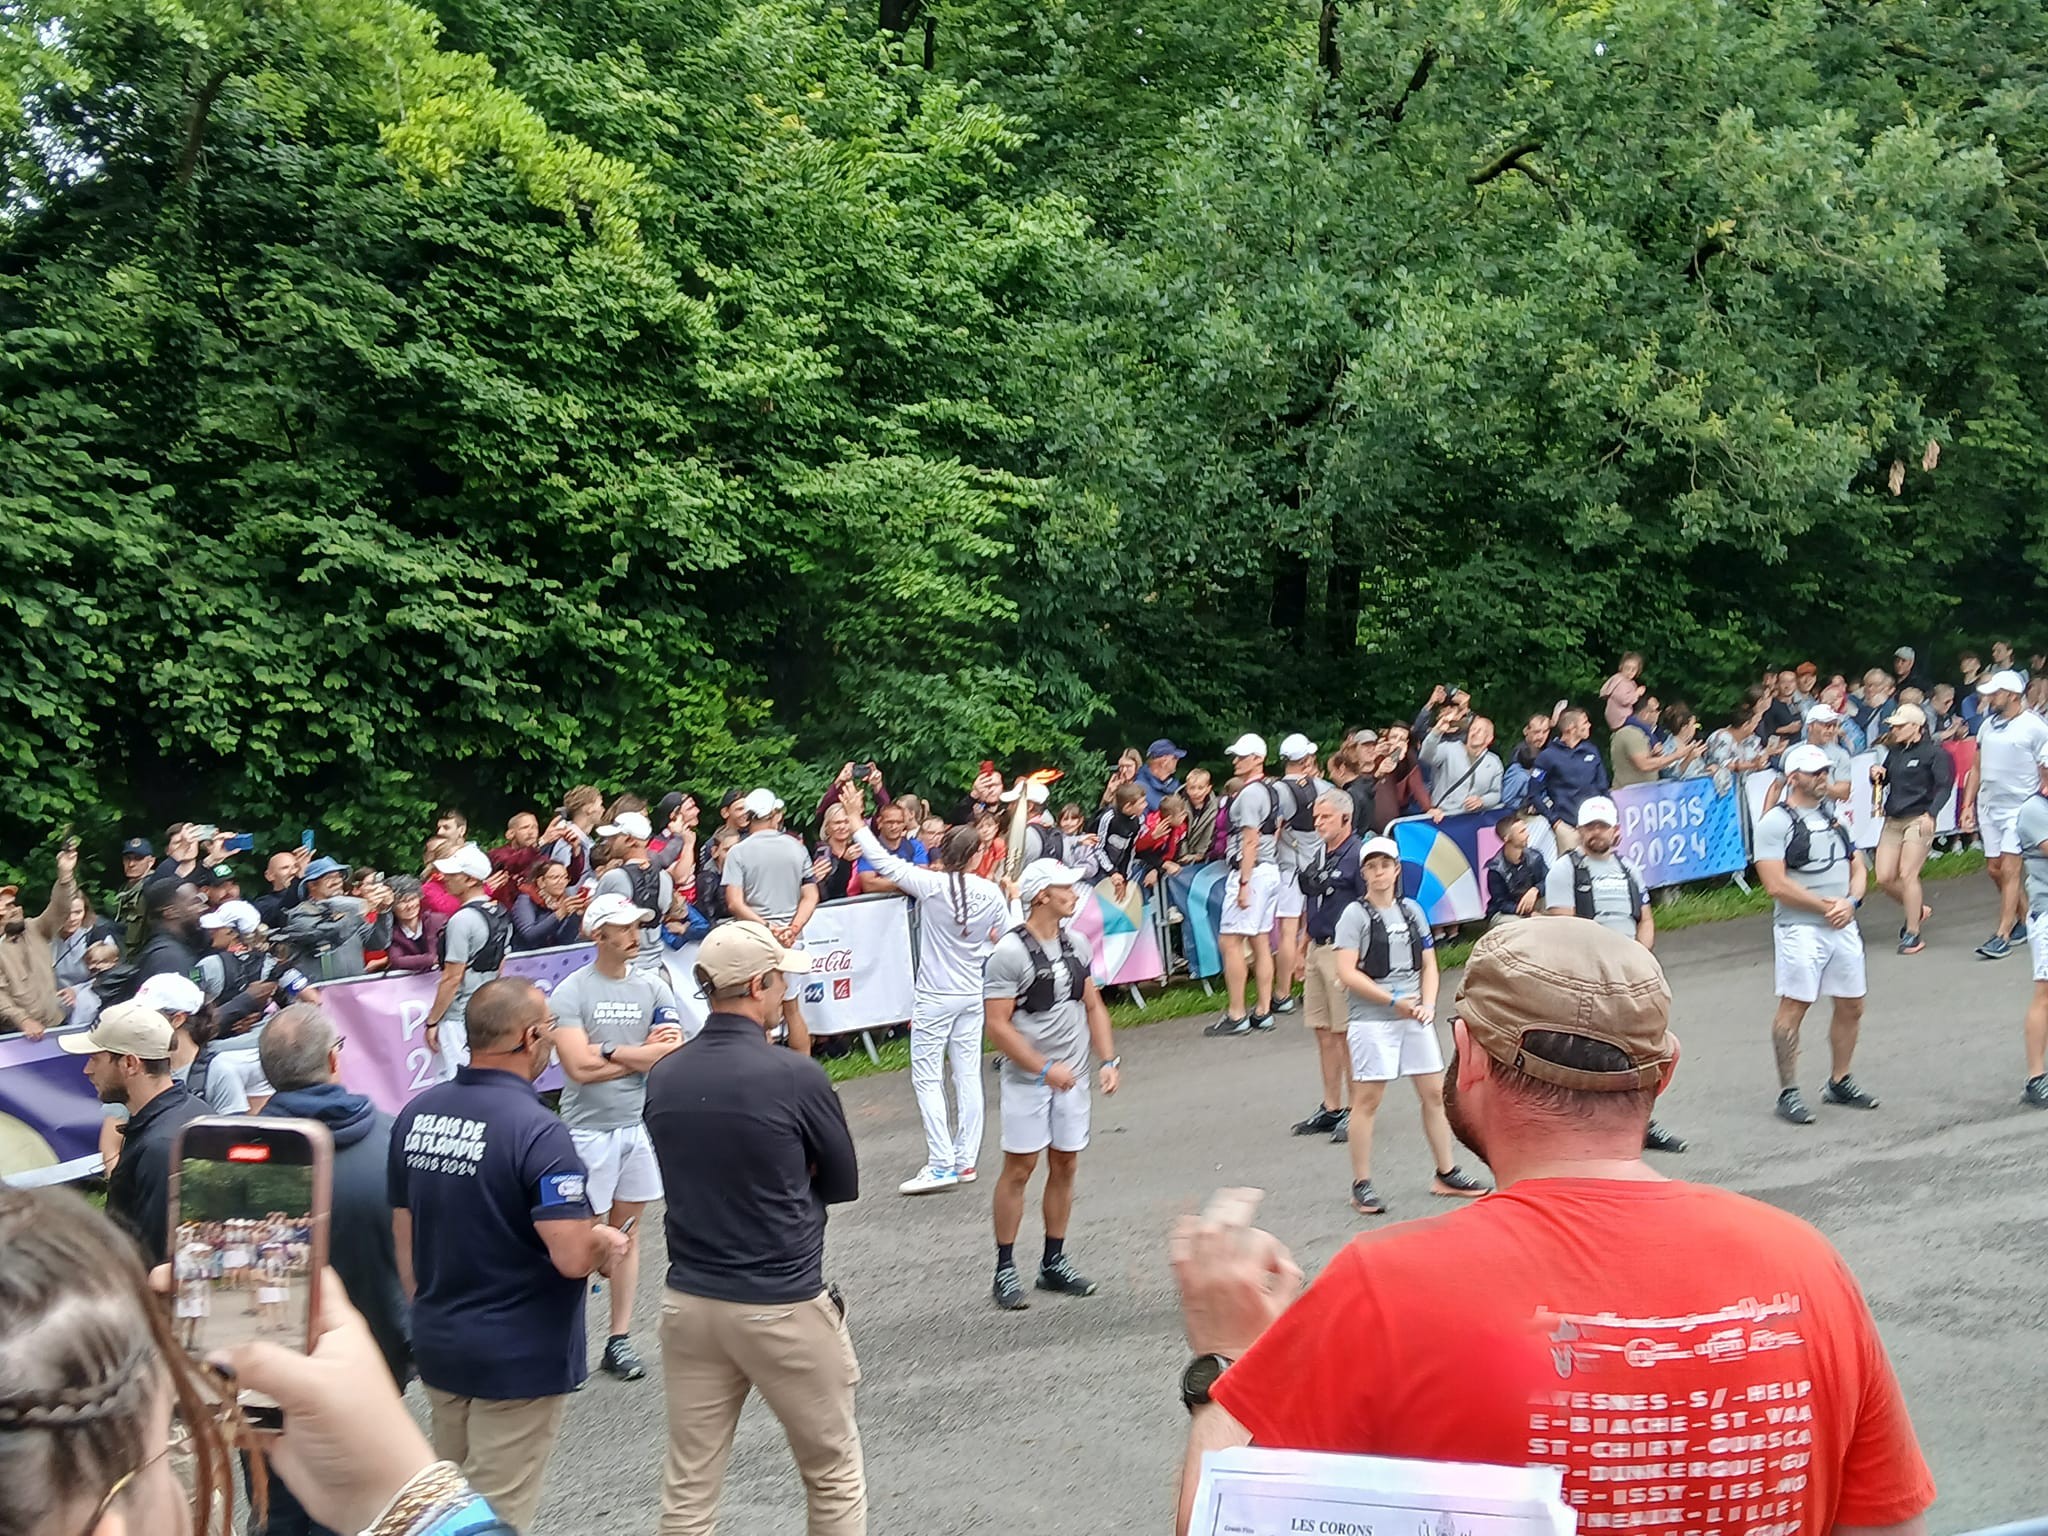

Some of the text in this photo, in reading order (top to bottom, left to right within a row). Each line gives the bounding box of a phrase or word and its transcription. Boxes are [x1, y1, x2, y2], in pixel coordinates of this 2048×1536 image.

[1628, 831, 1706, 871] 2024
[411, 1113, 487, 1140] RELAIS DE
[404, 1132, 421, 1152] LA
[441, 1158, 477, 1177] 2024
[1291, 1518, 1373, 1536] LES CORONS
